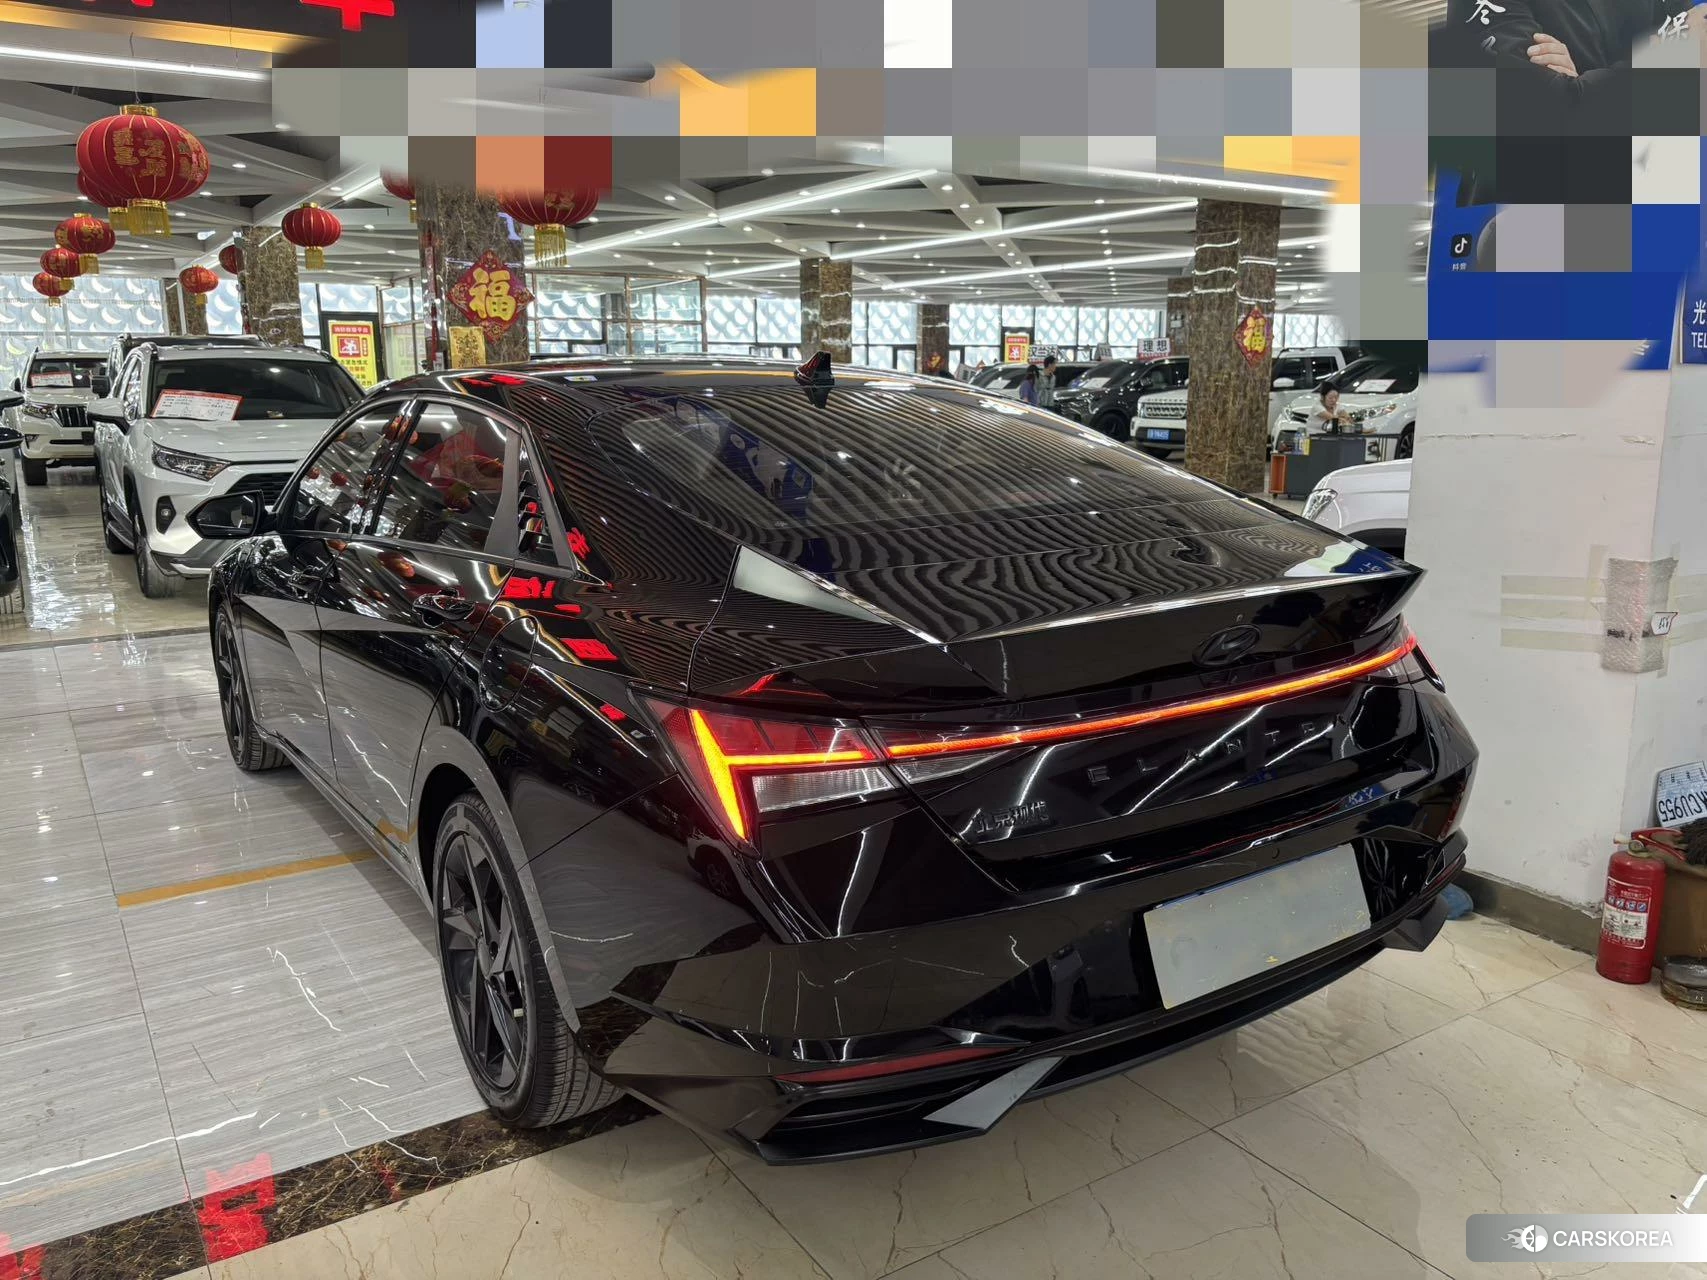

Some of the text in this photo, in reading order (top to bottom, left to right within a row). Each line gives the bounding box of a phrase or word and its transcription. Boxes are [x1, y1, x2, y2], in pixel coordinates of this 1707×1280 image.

[469, 267, 516, 321] 福
[1692, 299, 1707, 325] 光
[1143, 339, 1167, 351] 理想
[1243, 316, 1266, 353] 福
[1087, 711, 1347, 784] ELANTRA
[976, 800, 1049, 834] 北京现代
